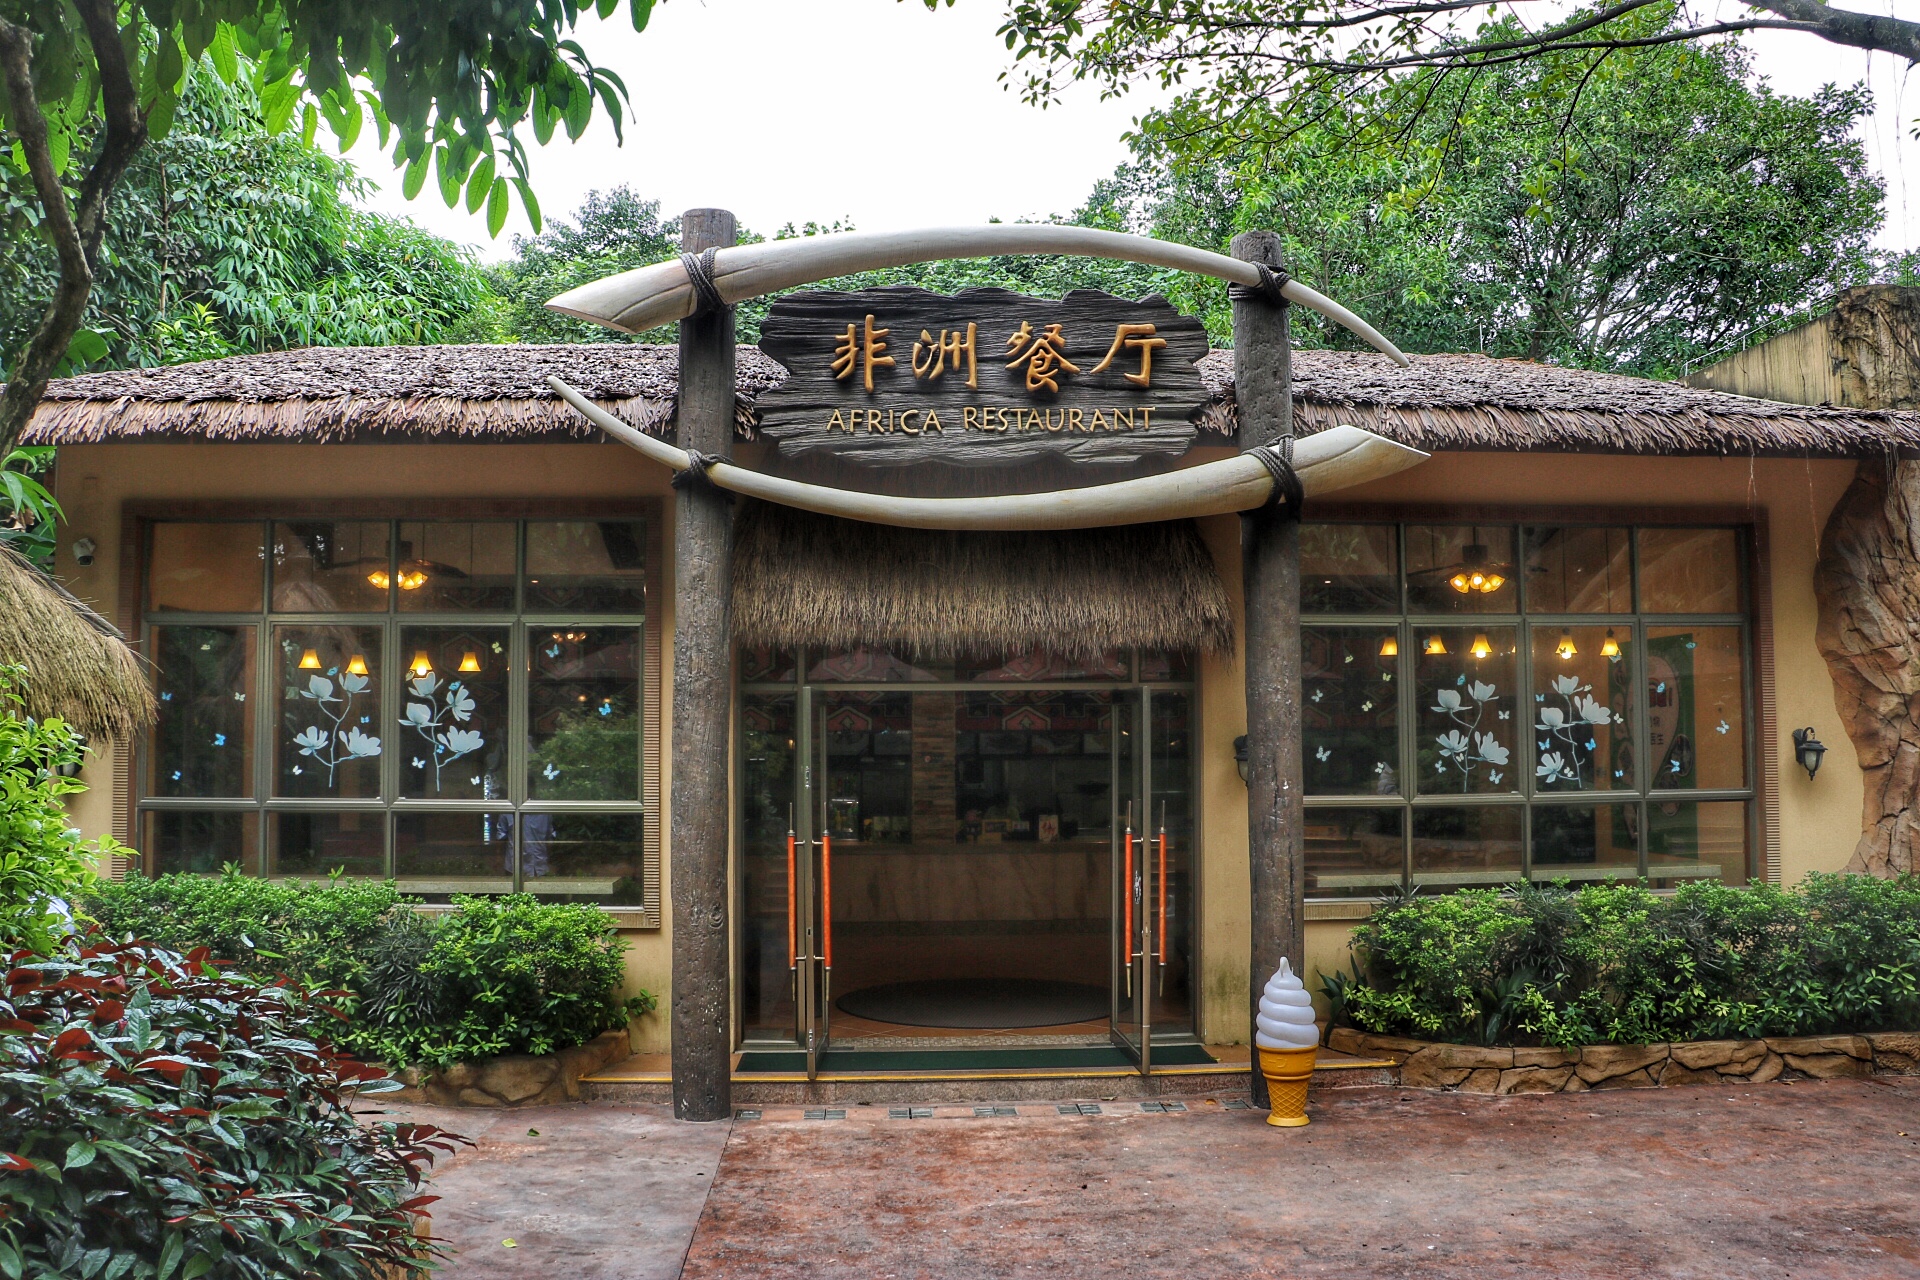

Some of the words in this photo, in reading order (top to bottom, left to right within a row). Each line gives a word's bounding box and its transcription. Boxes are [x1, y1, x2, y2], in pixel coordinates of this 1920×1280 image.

[830, 313, 1168, 395] 非洲餐厅
[826, 408, 942, 435] AFRICA
[963, 406, 1156, 433] RESTAURANT
